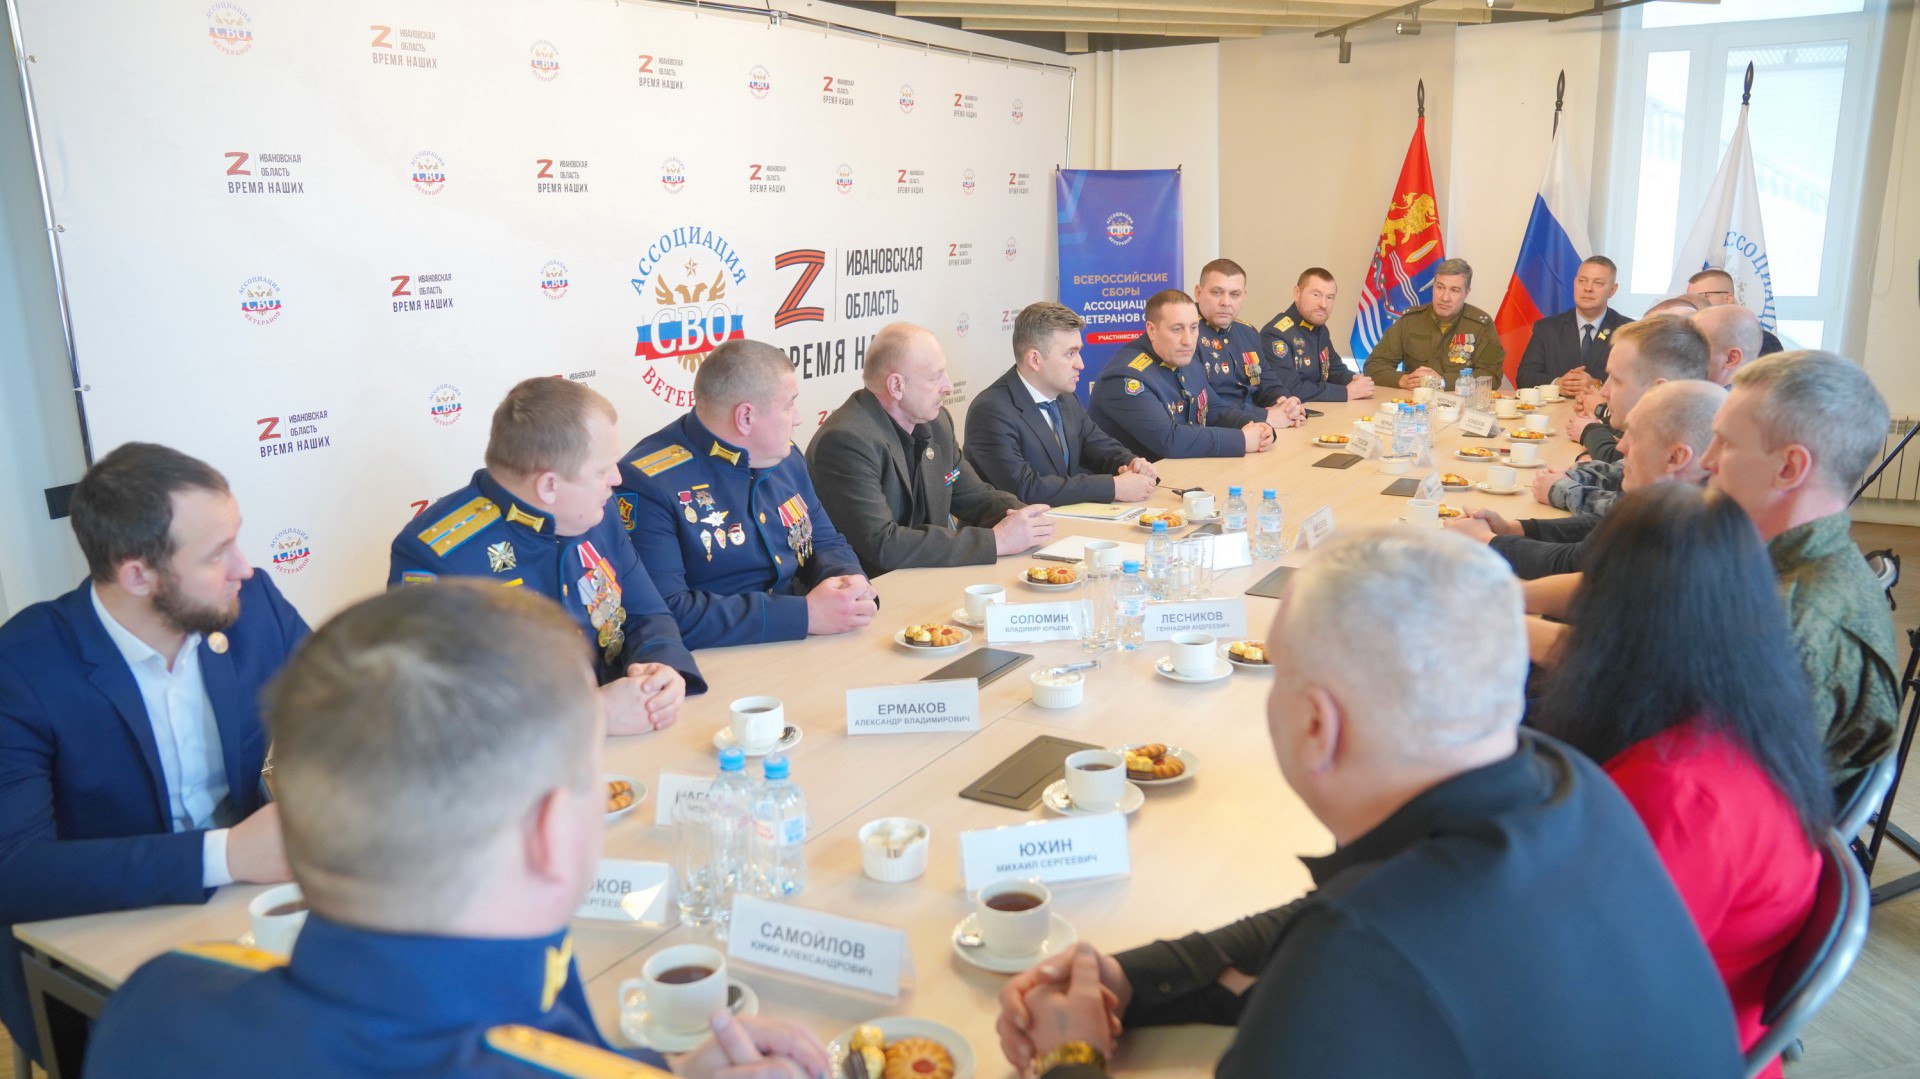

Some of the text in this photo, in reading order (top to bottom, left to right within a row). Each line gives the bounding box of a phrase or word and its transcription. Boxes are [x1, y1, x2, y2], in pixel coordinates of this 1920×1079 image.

[370, 25, 392, 48] Z
[400, 29, 436, 40] ИВАНОВСКАЯ
[401, 42, 426, 52] ОБЛАСТЬ
[373, 53, 437, 69] ВРЕМЯ НАШИХ
[639, 55, 653, 73] Z
[639, 78, 683, 90] ВРЕМЯ НАШИХ
[823, 76, 833, 92] Z
[954, 94, 962, 107] Z
[225, 152, 251, 176] Z
[259, 154, 301, 163] ИВАНОВСКАЯ
[560, 160, 588, 168] ИВАНОВСКАЯ
[261, 167, 290, 177] ОБЛАСТЬ
[537, 159, 553, 178] Z
[560, 171, 580, 179] ОБЛАСТЬ
[750, 164, 761, 180] Z
[898, 170, 906, 183] Z
[228, 182, 304, 194] ВРЕМЯ НАШИХ
[538, 183, 588, 193] ВРЕМЯ НАШИХ
[631, 226, 746, 295] АССОЦИАЦИЯ
[847, 247, 923, 276] ИВАНОВСКАЯ
[418, 274, 452, 283] ИВАНОВСКАЯ
[1074, 272, 1168, 284] ВСЕРОССИЙСКИЕ
[391, 275, 411, 297] Z
[419, 287, 442, 295] ОБЛАСТЬ
[775, 249, 825, 329] Z
[1102, 287, 1140, 297] СБОРЫ
[246, 300, 277, 311] СВО
[393, 298, 453, 313] ВРЕМЯ НАШИХ
[845, 290, 898, 320] ОБЛАСТЬ
[1084, 300, 1146, 311] АССОЦИАЦ
[650, 303, 732, 354] СВО
[1098, 333, 1142, 341] УЧАСТНИКСВО
[780, 339, 845, 380] РЕМЯ
[642, 366, 696, 407] ВЕТЕР
[288, 410, 328, 423] ИВАНОВСКАЯ
[257, 417, 281, 441] Z
[290, 425, 317, 436] ОБЛАСТЬ
[260, 436, 330, 458] ВРЕМЯ НАШИХ
[277, 548, 306, 562] СВО
[1010, 614, 1068, 624] СОЛОМИН
[1161, 612, 1223, 623] ЛЕСНИКОВ
[878, 702, 946, 715] ЕРМАКОВ
[904, 716, 970, 724] ВЛАДИМИРОВИЧ
[1020, 838, 1072, 857] ЮХИН
[997, 854, 1098, 873] МИХАИЛ СЕРГЕЕВИЧ
[761, 922, 865, 959] САМОЙЛОВ
[751, 940, 872, 976] ЮРИЙ АЛЕКСАНДРОВИЧ
